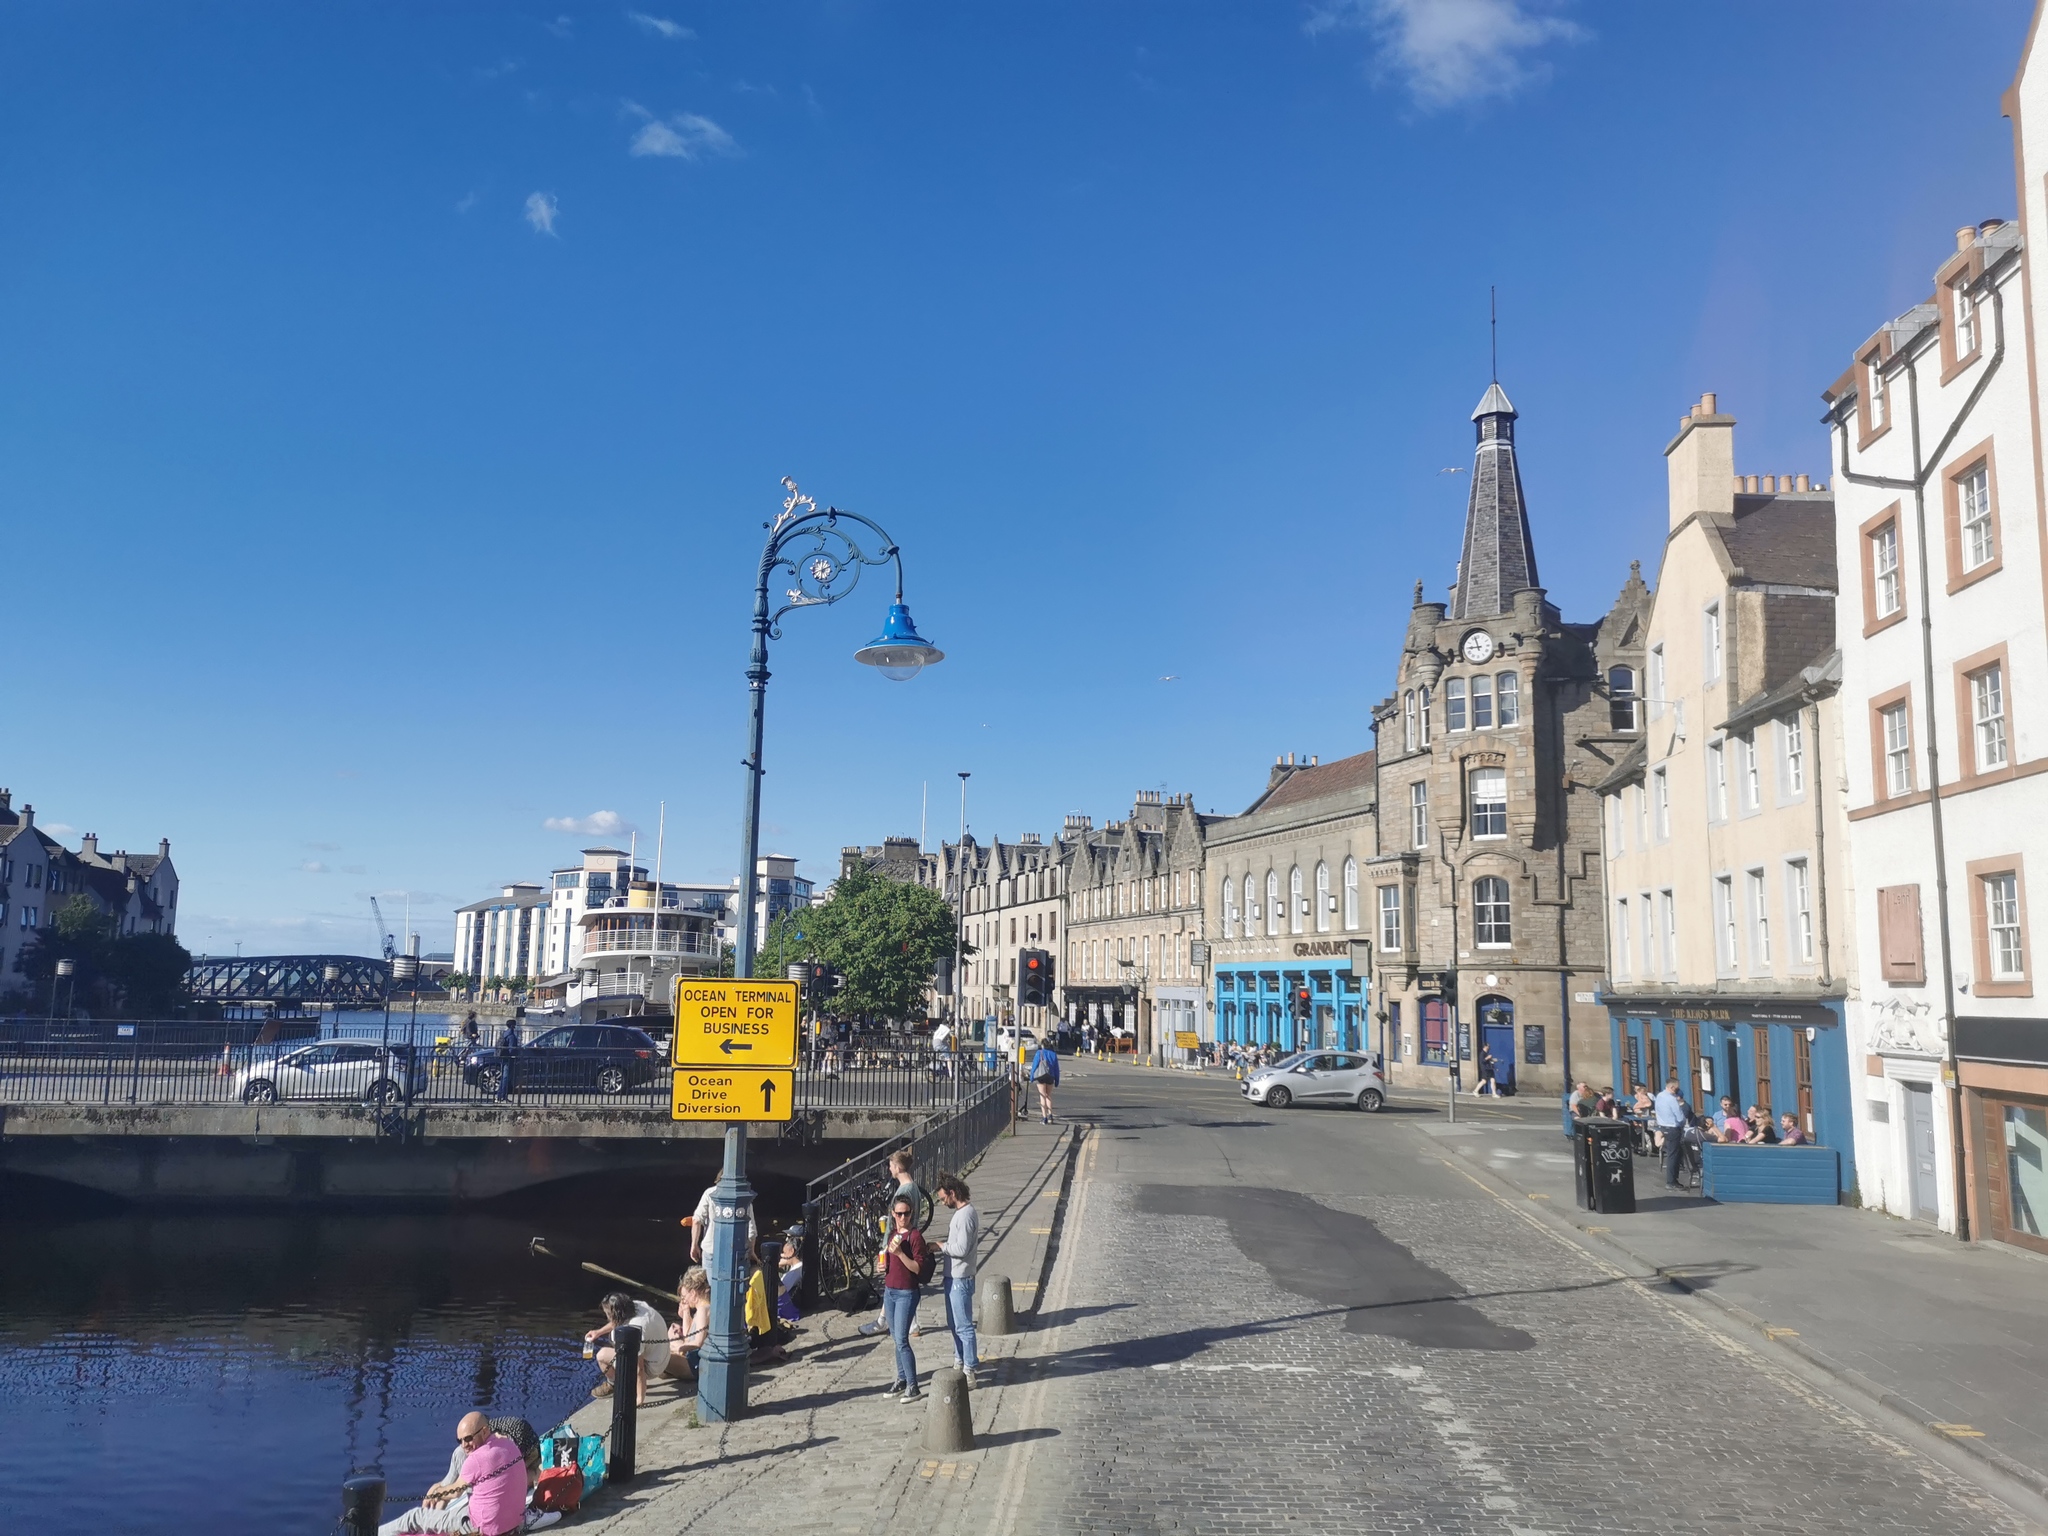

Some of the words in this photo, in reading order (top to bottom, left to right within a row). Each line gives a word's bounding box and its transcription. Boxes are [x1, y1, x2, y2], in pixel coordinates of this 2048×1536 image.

[1293, 941, 1349, 957] GRANARY
[684, 989, 726, 1002] OCEAN
[735, 990, 792, 1003] TERMINAL
[700, 1006, 737, 1018] OPEN
[747, 1007, 774, 1019] FOR
[703, 1022, 770, 1035] BUSINESS
[688, 1075, 733, 1086] Ocean
[691, 1089, 727, 1100] Drive
[677, 1103, 741, 1114] Diversion
